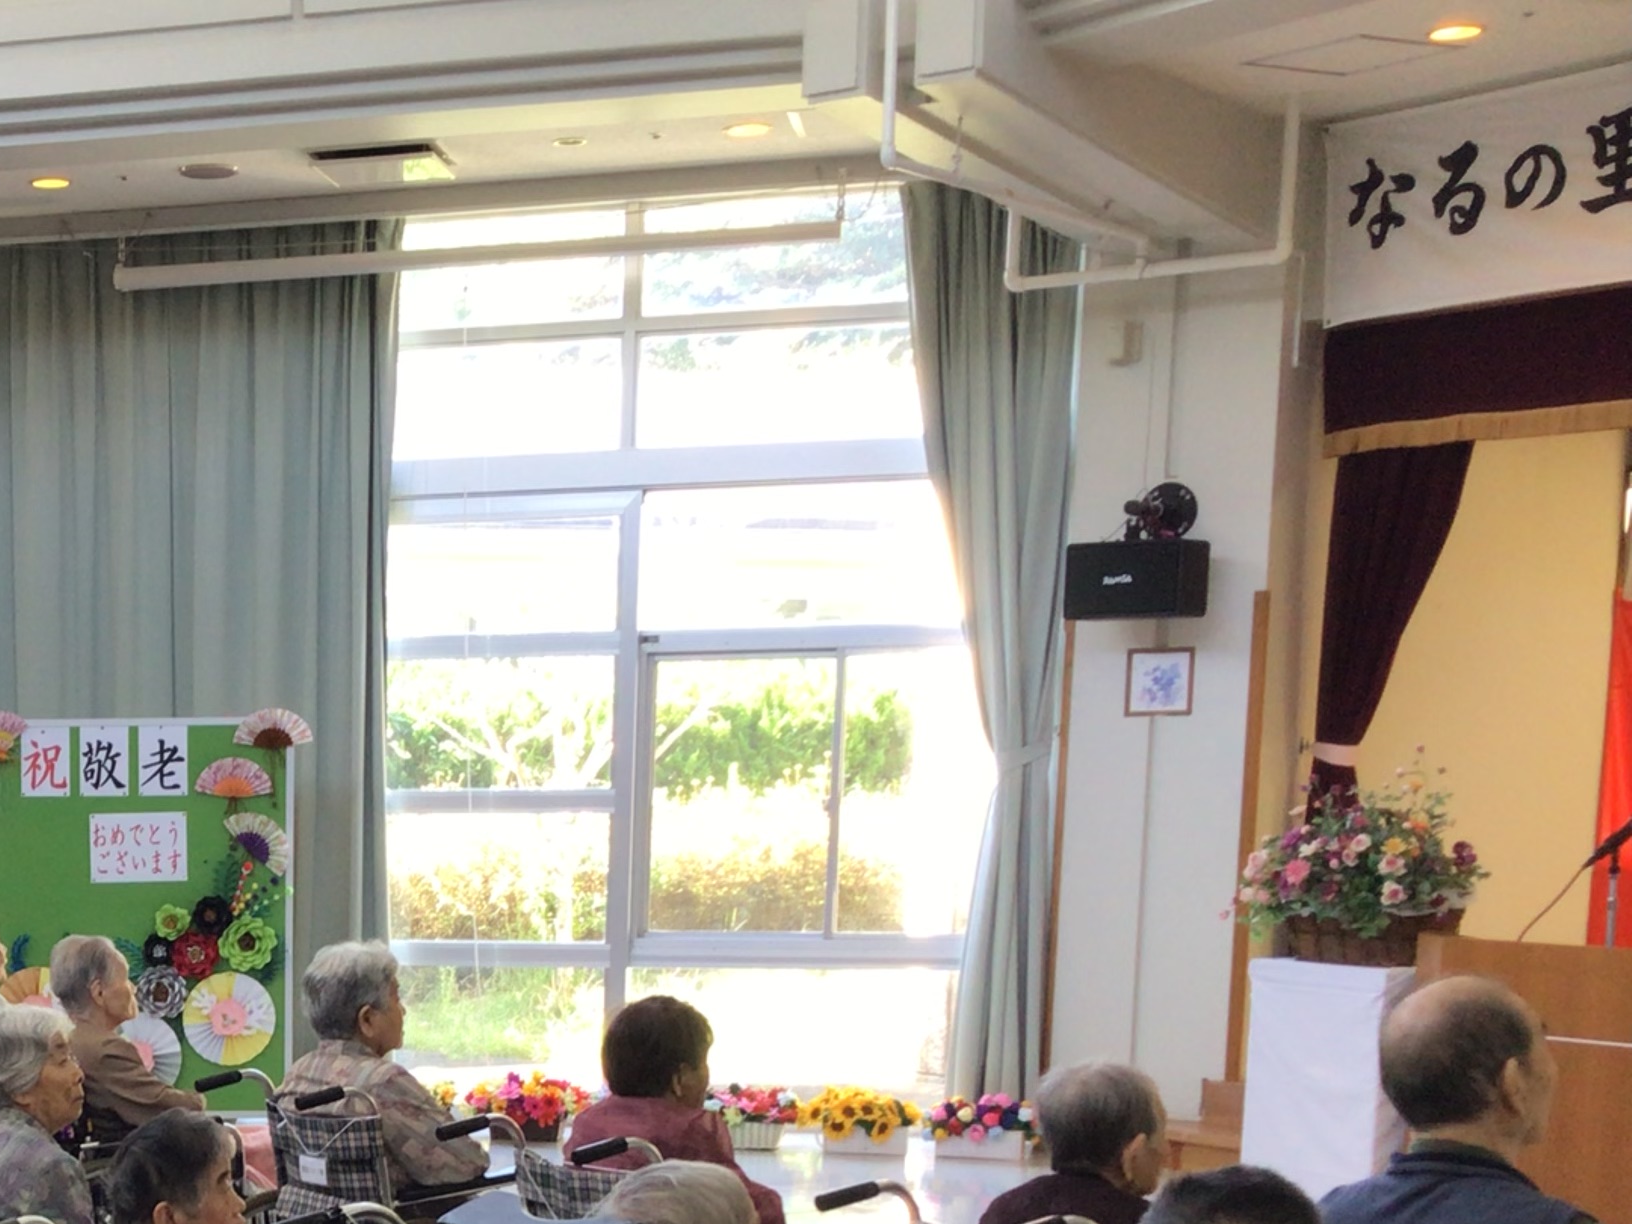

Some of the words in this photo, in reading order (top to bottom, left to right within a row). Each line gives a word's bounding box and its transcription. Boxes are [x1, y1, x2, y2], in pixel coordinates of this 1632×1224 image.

[93, 821, 178, 848] おめでとう
[97, 849, 181, 875] ございます
